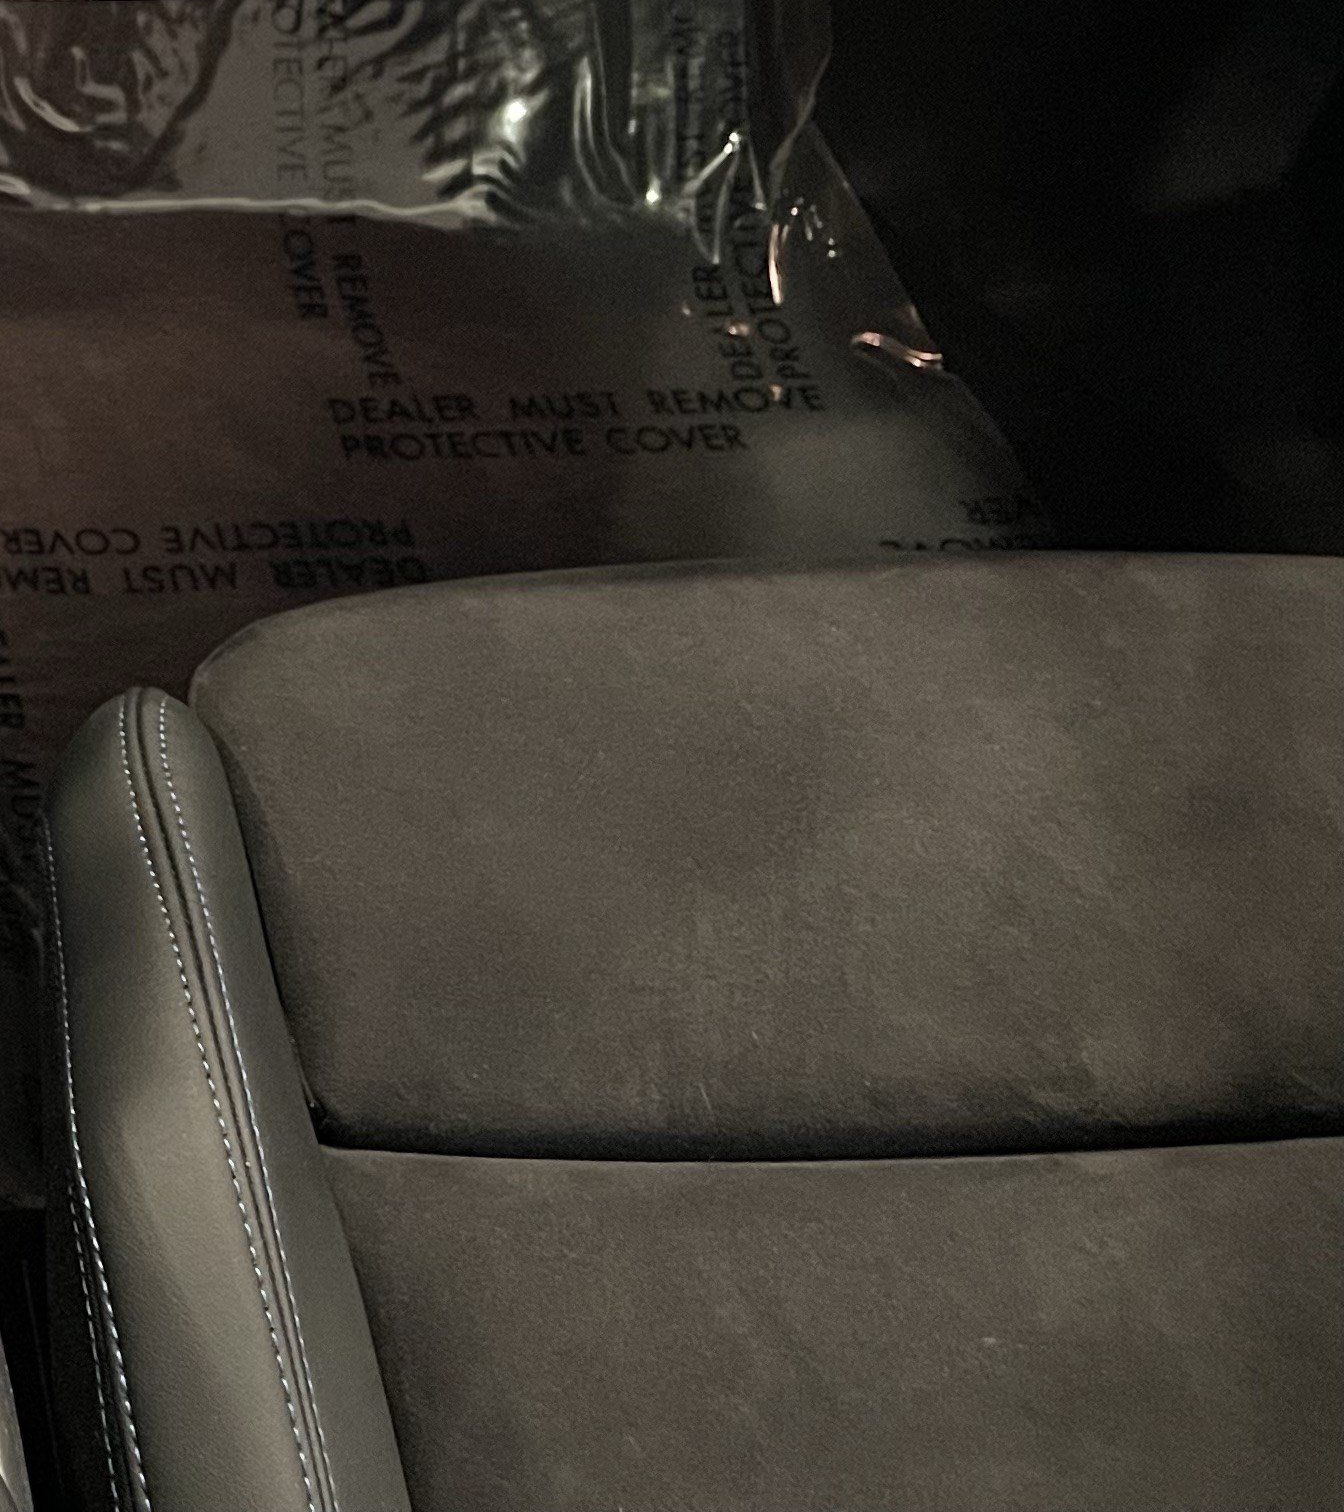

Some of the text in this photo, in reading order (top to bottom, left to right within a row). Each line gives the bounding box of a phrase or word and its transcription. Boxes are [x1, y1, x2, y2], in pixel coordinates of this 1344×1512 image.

[326, 384, 827, 426] DEALER MUST REMOVE
[340, 423, 750, 462] PROTECTIVE COVER
